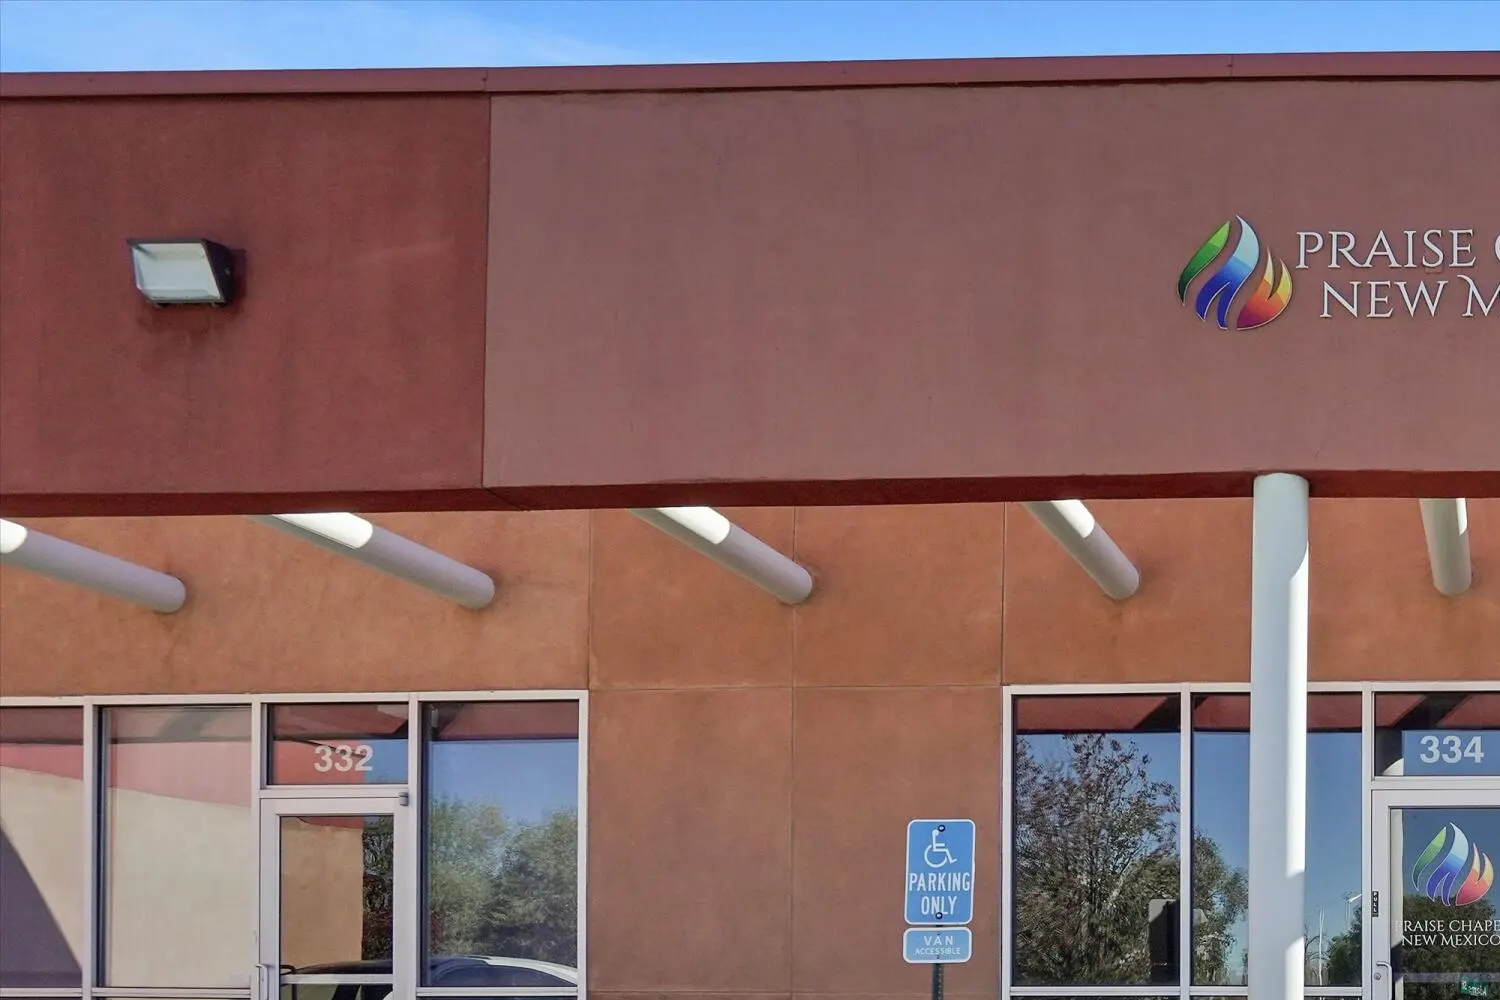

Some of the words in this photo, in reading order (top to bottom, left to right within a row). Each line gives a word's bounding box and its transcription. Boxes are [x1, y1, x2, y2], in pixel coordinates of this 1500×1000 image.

[1296, 229, 1476, 269] PRAISE
[1319, 280, 1448, 318] NEW
[313, 744, 373, 772] 332
[1420, 735, 1484, 763] 334
[909, 872, 970, 891] PARKING
[921, 895, 957, 915] ONLY
[1395, 919, 1445, 932] PRAISE
[923, 935, 953, 946] VAN
[1400, 934, 1438, 946] NEW
